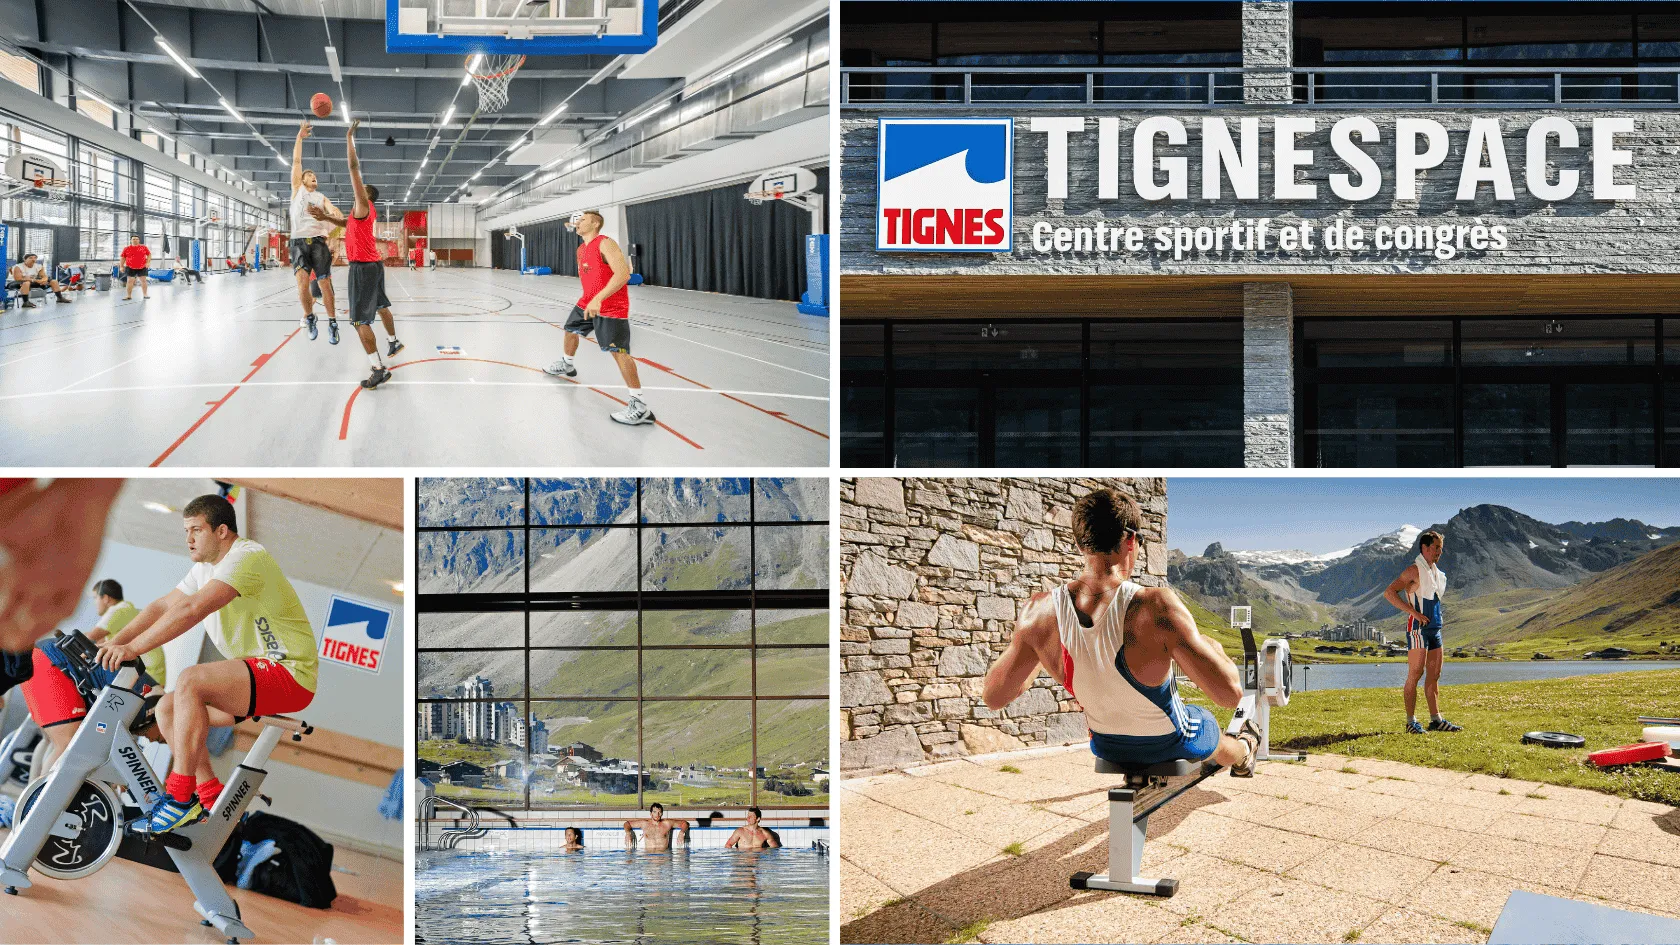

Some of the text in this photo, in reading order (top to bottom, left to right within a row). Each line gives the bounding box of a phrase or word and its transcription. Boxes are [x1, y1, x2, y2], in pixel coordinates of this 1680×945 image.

[1030, 114, 1638, 203] TIGNESPACE
[883, 208, 1006, 246] TIGNES
[1031, 216, 1509, 260] Centre sportif et de congrès
[322, 637, 381, 670] TIGNES
[118, 746, 158, 796] SPINNER
[222, 780, 251, 822] SPINNER
